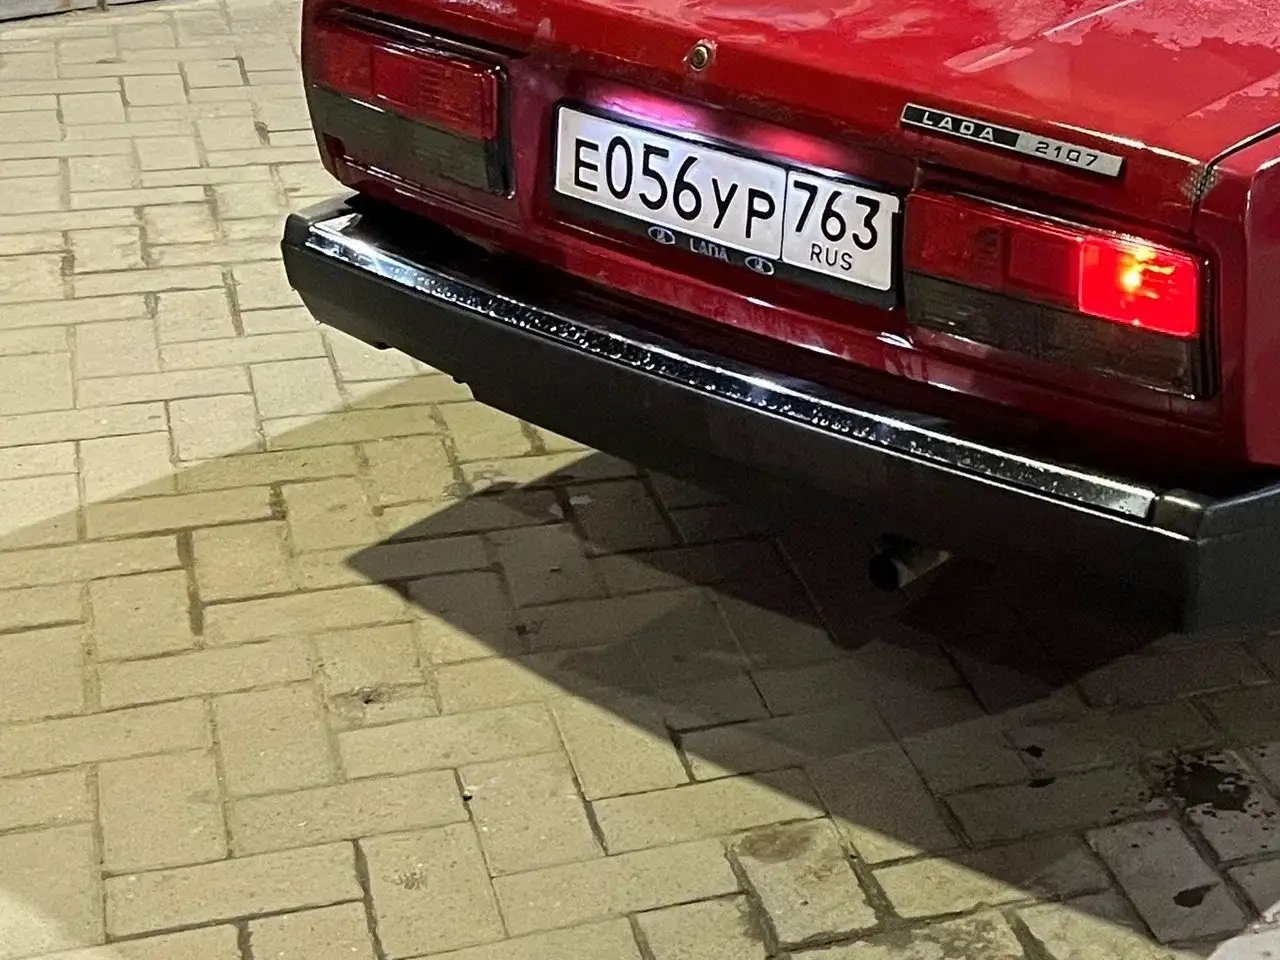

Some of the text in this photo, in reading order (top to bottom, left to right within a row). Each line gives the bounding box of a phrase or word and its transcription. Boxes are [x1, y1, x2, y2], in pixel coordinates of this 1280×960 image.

[923, 111, 1100, 168] LADA 2107
[574, 136, 878, 250] Е056УР 763
[690, 238, 731, 264] LADA
[810, 244, 853, 271] RUS
